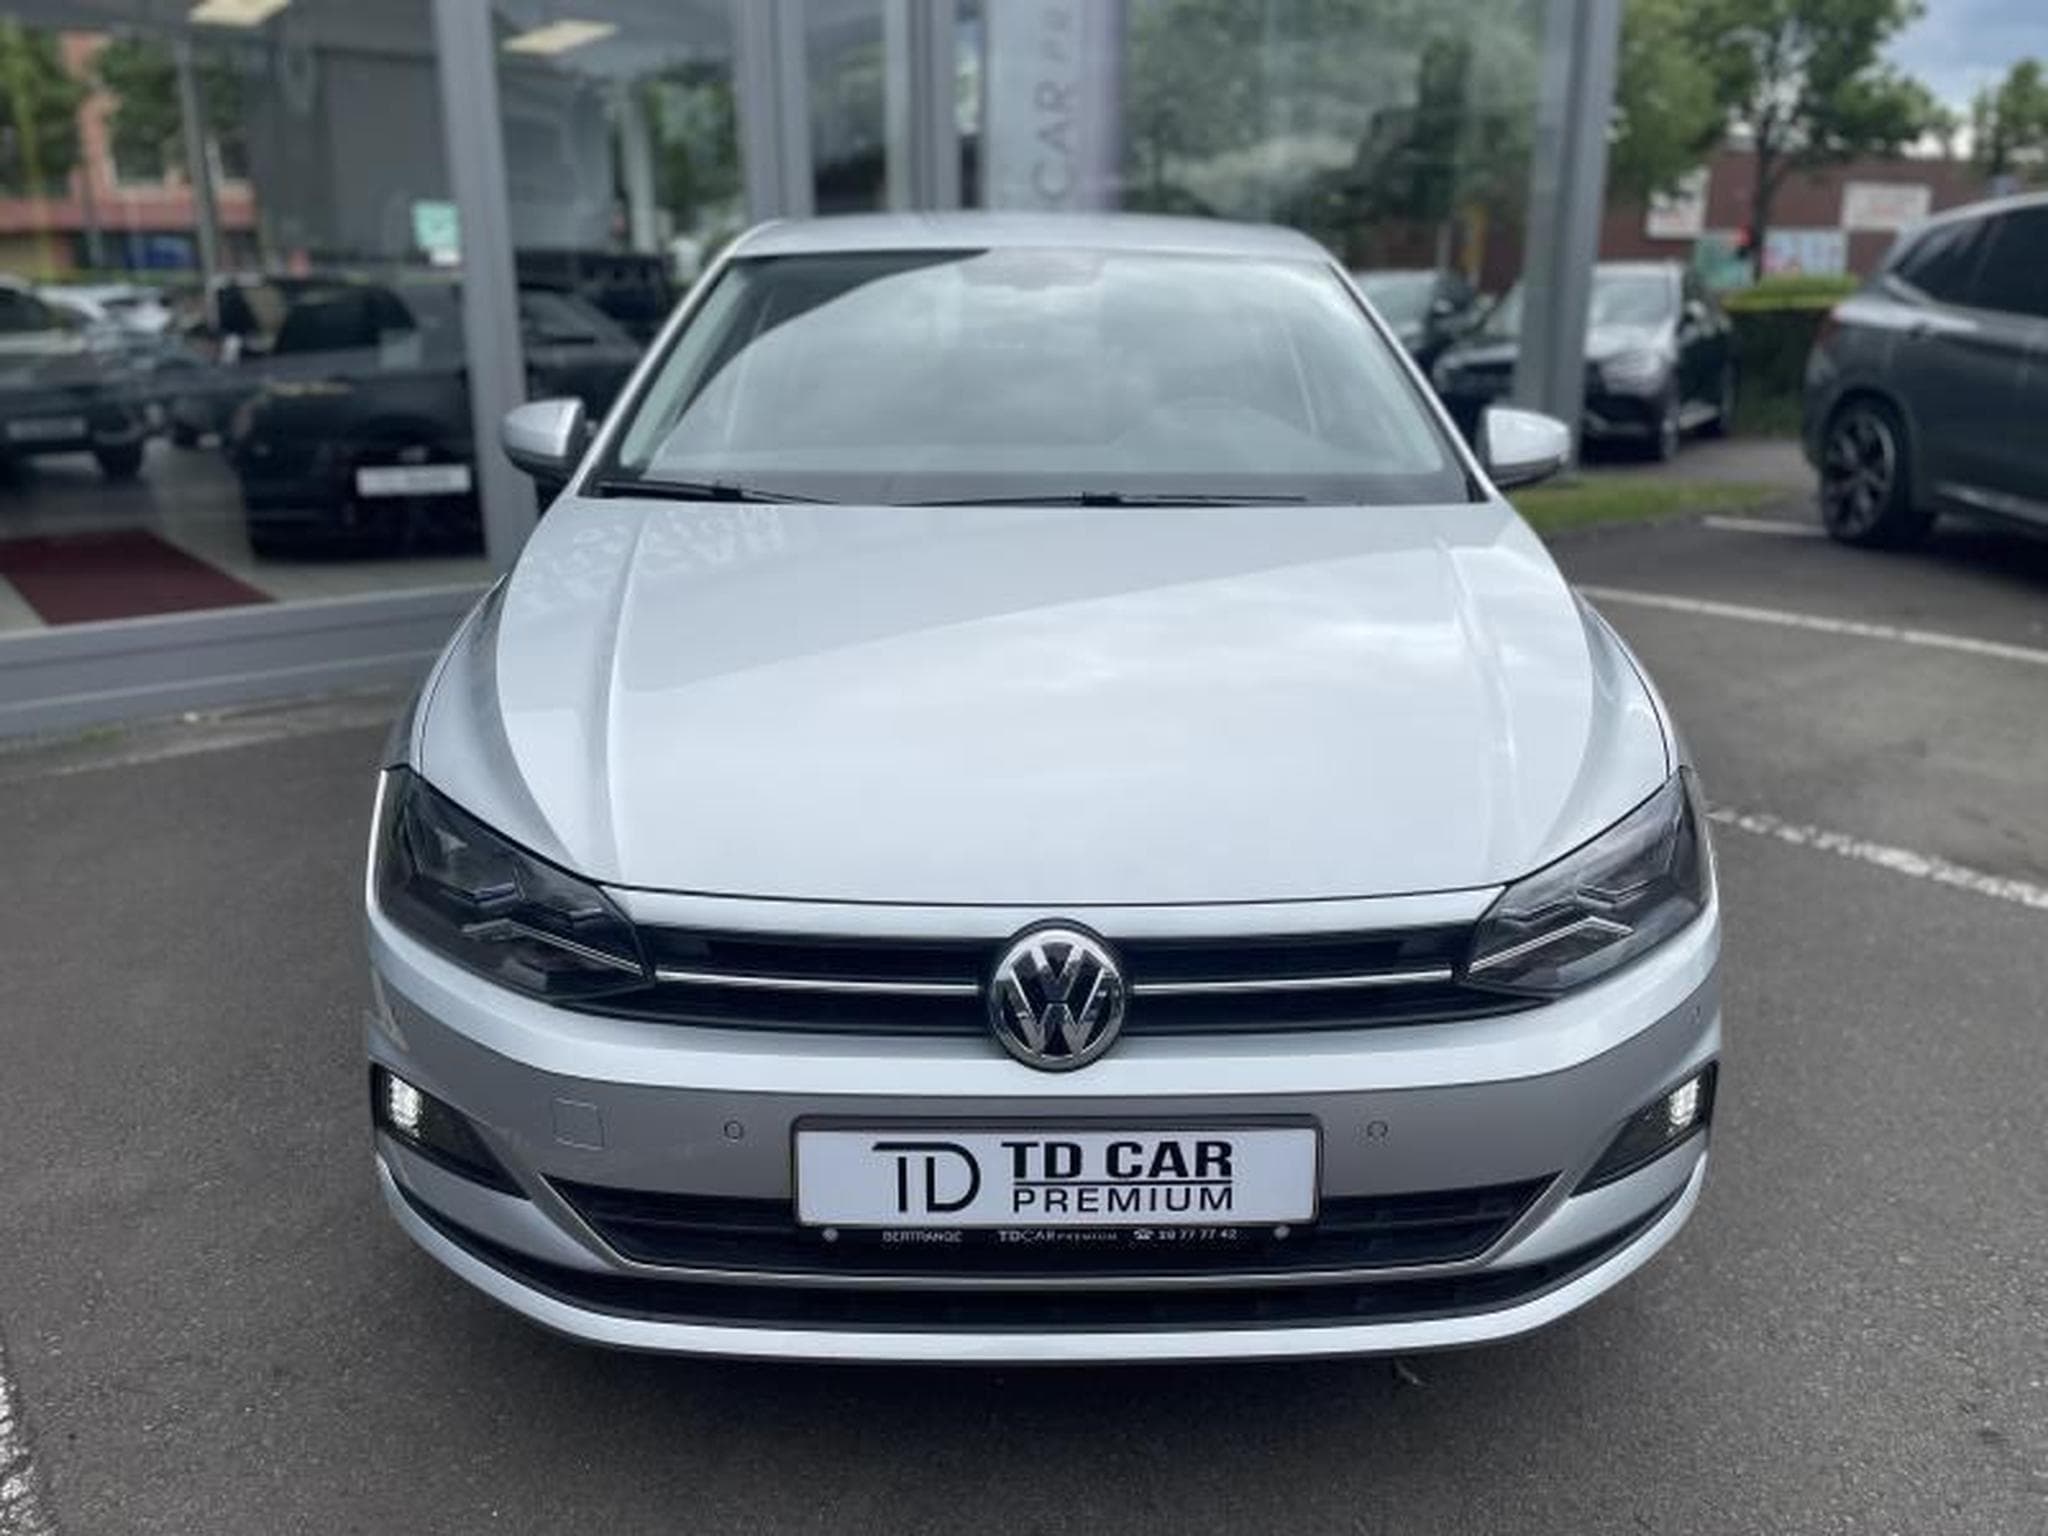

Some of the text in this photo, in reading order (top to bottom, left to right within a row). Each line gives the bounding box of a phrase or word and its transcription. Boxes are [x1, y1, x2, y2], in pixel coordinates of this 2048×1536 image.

[1031, 80, 1078, 206] CAR
[872, 1141, 981, 1213] TD
[1001, 1141, 1233, 1178] TD CAR
[1013, 1187, 1233, 1213] PREMIUM
